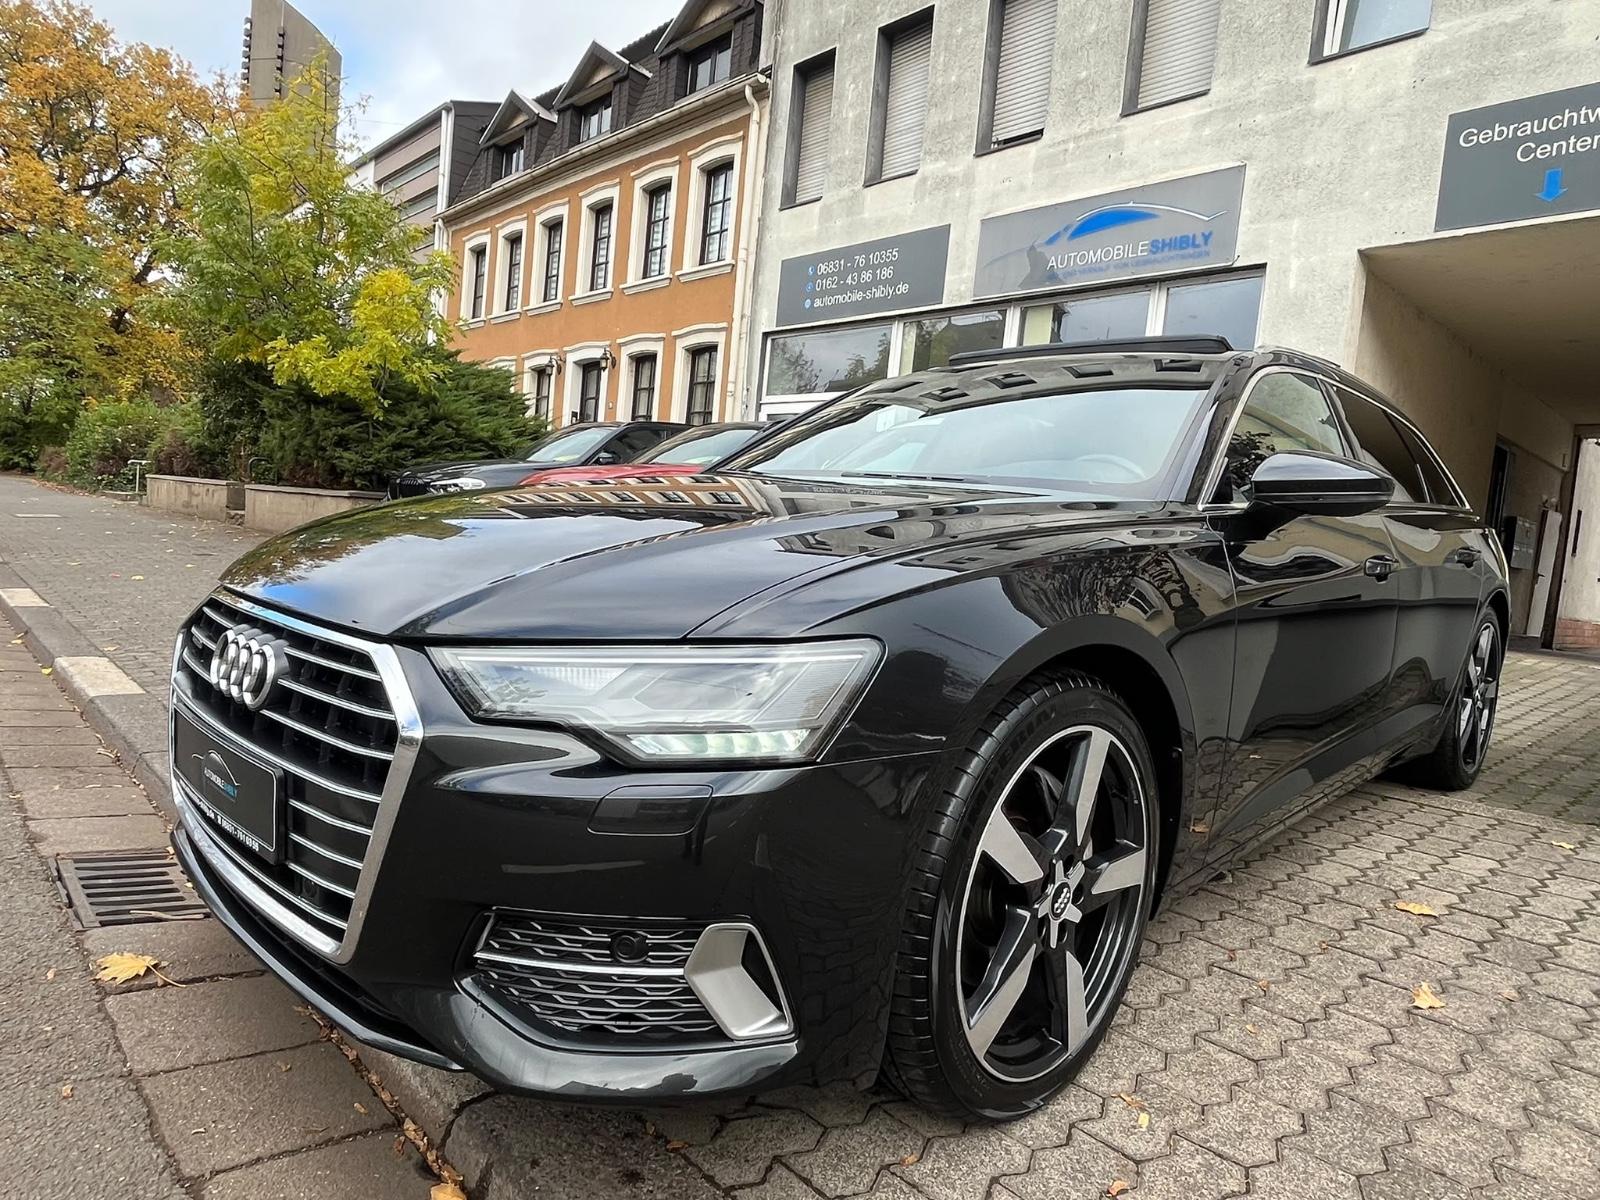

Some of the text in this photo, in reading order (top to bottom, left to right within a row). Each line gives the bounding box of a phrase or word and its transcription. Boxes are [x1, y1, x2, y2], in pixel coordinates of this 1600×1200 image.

[1516, 134, 1600, 162] Center
[817, 259, 844, 275] 06831
[853, 254, 866, 268] 76
[868, 248, 899, 265] 10355
[1046, 230, 1213, 271] AUTOMOBILESHIBLY
[815, 276, 838, 291] 0162
[846, 272, 858, 285] 43
[860, 269, 873, 283] 86
[875, 265, 894, 280] 186
[813, 281, 909, 308] automobile-shibly.de
